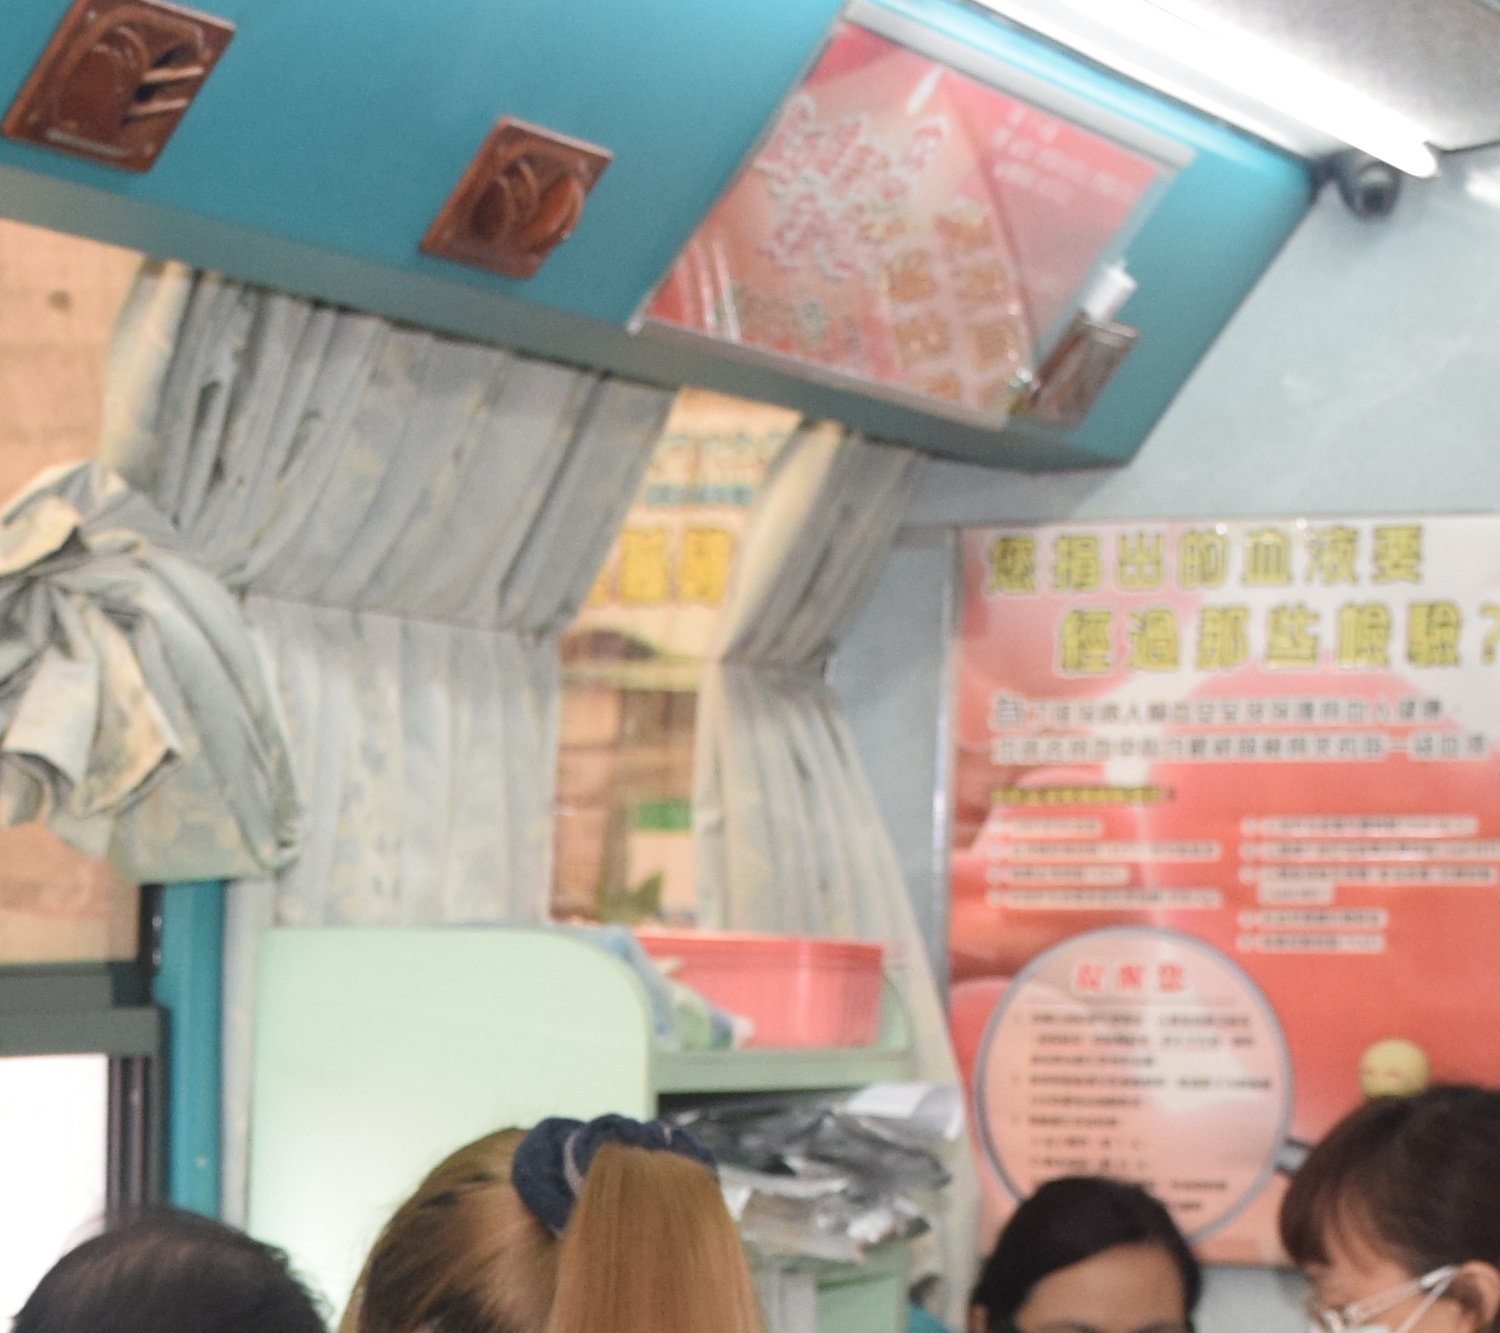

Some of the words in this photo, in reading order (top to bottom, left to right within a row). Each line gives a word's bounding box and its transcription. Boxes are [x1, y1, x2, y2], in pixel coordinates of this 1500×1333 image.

[989, 523, 1424, 592] 您捐出的血液要
